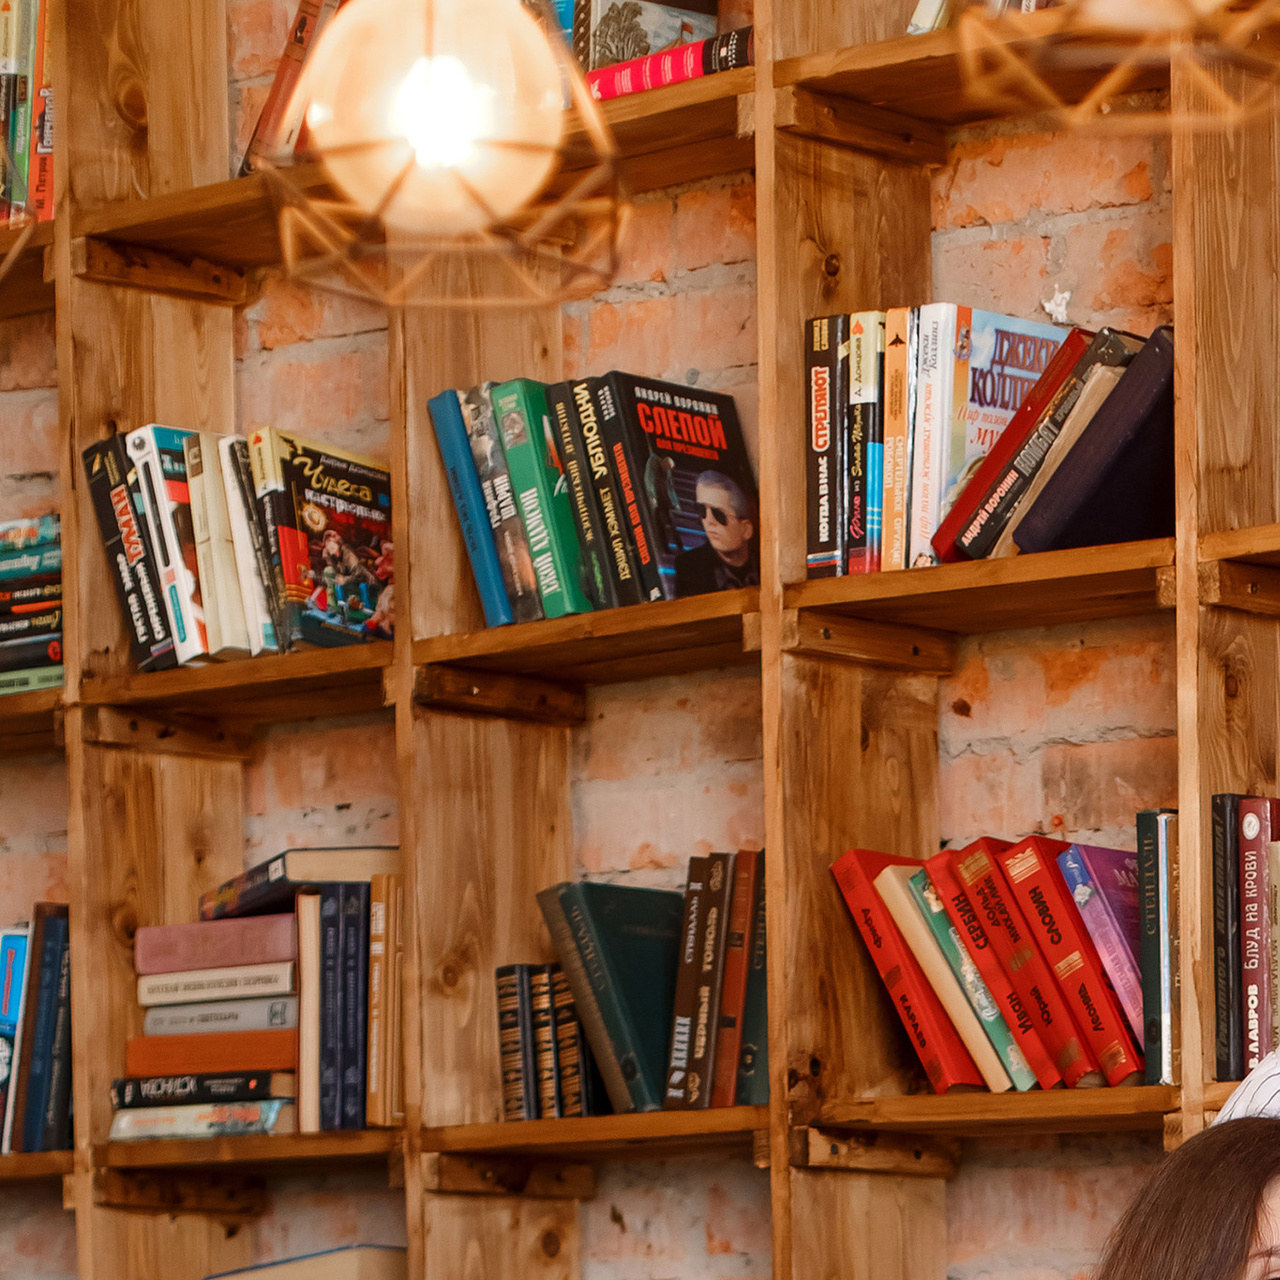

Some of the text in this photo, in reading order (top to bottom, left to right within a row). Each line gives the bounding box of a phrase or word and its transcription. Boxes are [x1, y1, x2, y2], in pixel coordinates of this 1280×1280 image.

[854, 337, 864, 386] Донцова
[636, 402, 728, 450] СЛЕПОЙ
[812, 367, 829, 452] СТРЕЛЯЮТ
[292, 456, 372, 501] Чудеса
[1013, 416, 1060, 477] КОМБАТ
[110, 484, 146, 566] ТУМАН
[817, 496, 830, 543] КОГДА
[961, 507, 991, 547] АНДРЕЙ
[984, 470, 1019, 513] ВОРОНИН
[984, 874, 1021, 945] МИХАЙЛИК
[1028, 885, 1063, 946] СЛОВИН
[1143, 832, 1157, 936] СТЕНДАЛЬ
[861, 907, 928, 1050] Ариф КАРАЕВ
[951, 893, 1034, 1036] Иван СЕРБИН
[1030, 984, 1053, 1027] Юрий
